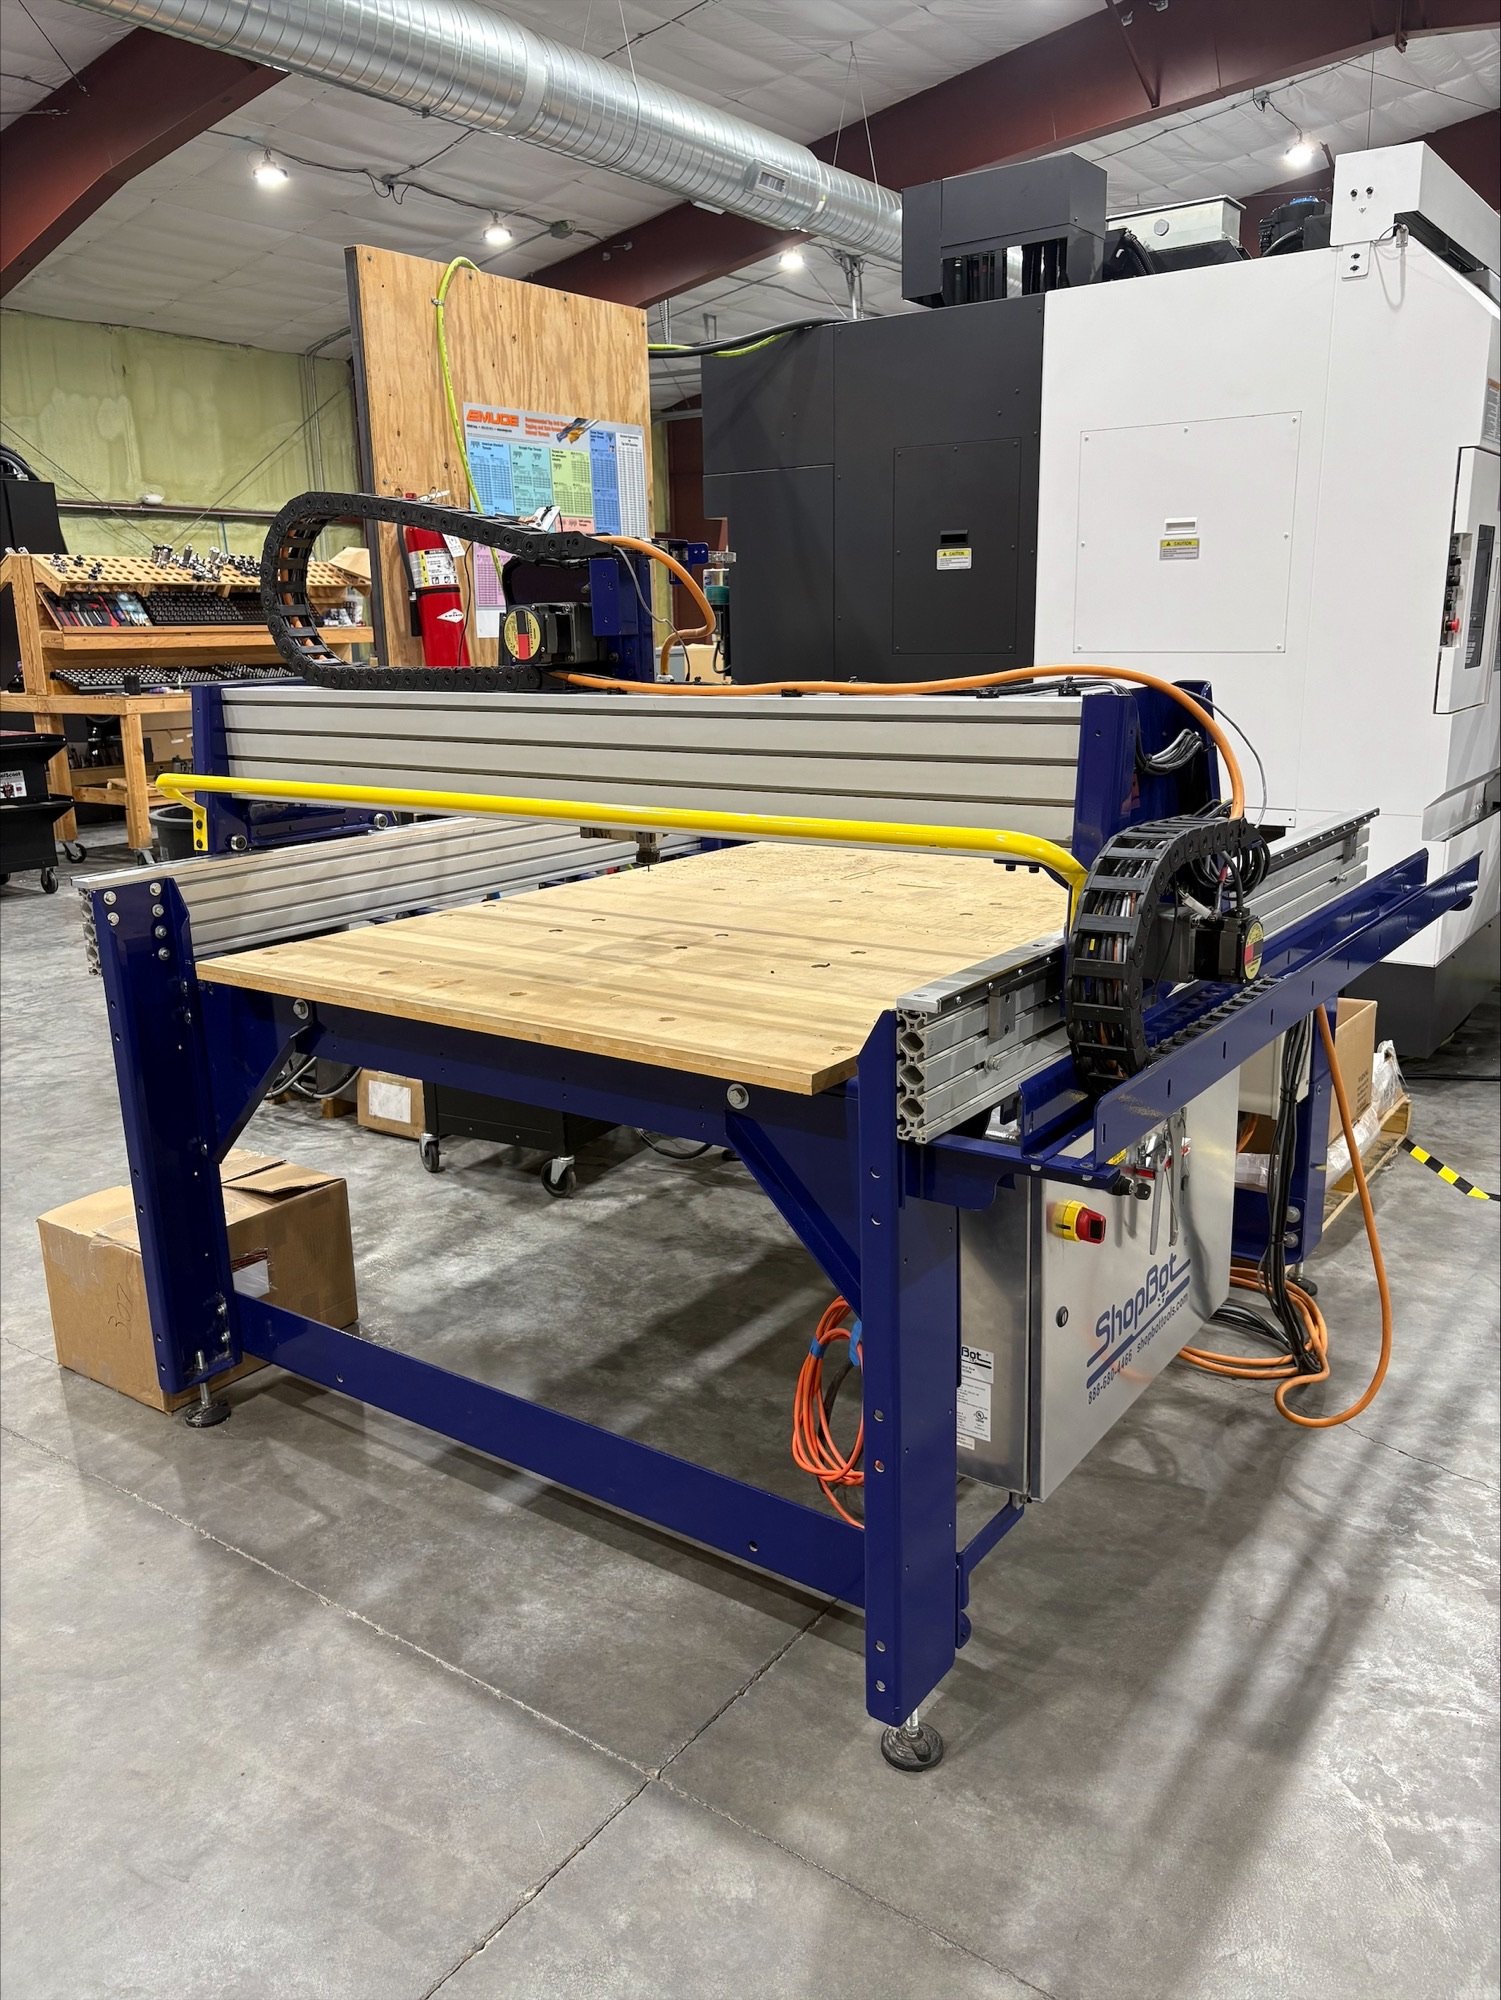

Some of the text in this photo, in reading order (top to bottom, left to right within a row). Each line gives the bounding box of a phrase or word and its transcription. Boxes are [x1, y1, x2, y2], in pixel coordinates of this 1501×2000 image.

[466, 409, 519, 427] EMUGE
[1087, 1253, 1191, 1367] ShopBot
[1088, 1293, 1189, 1405] 888-680-4466 shopbottools.com
